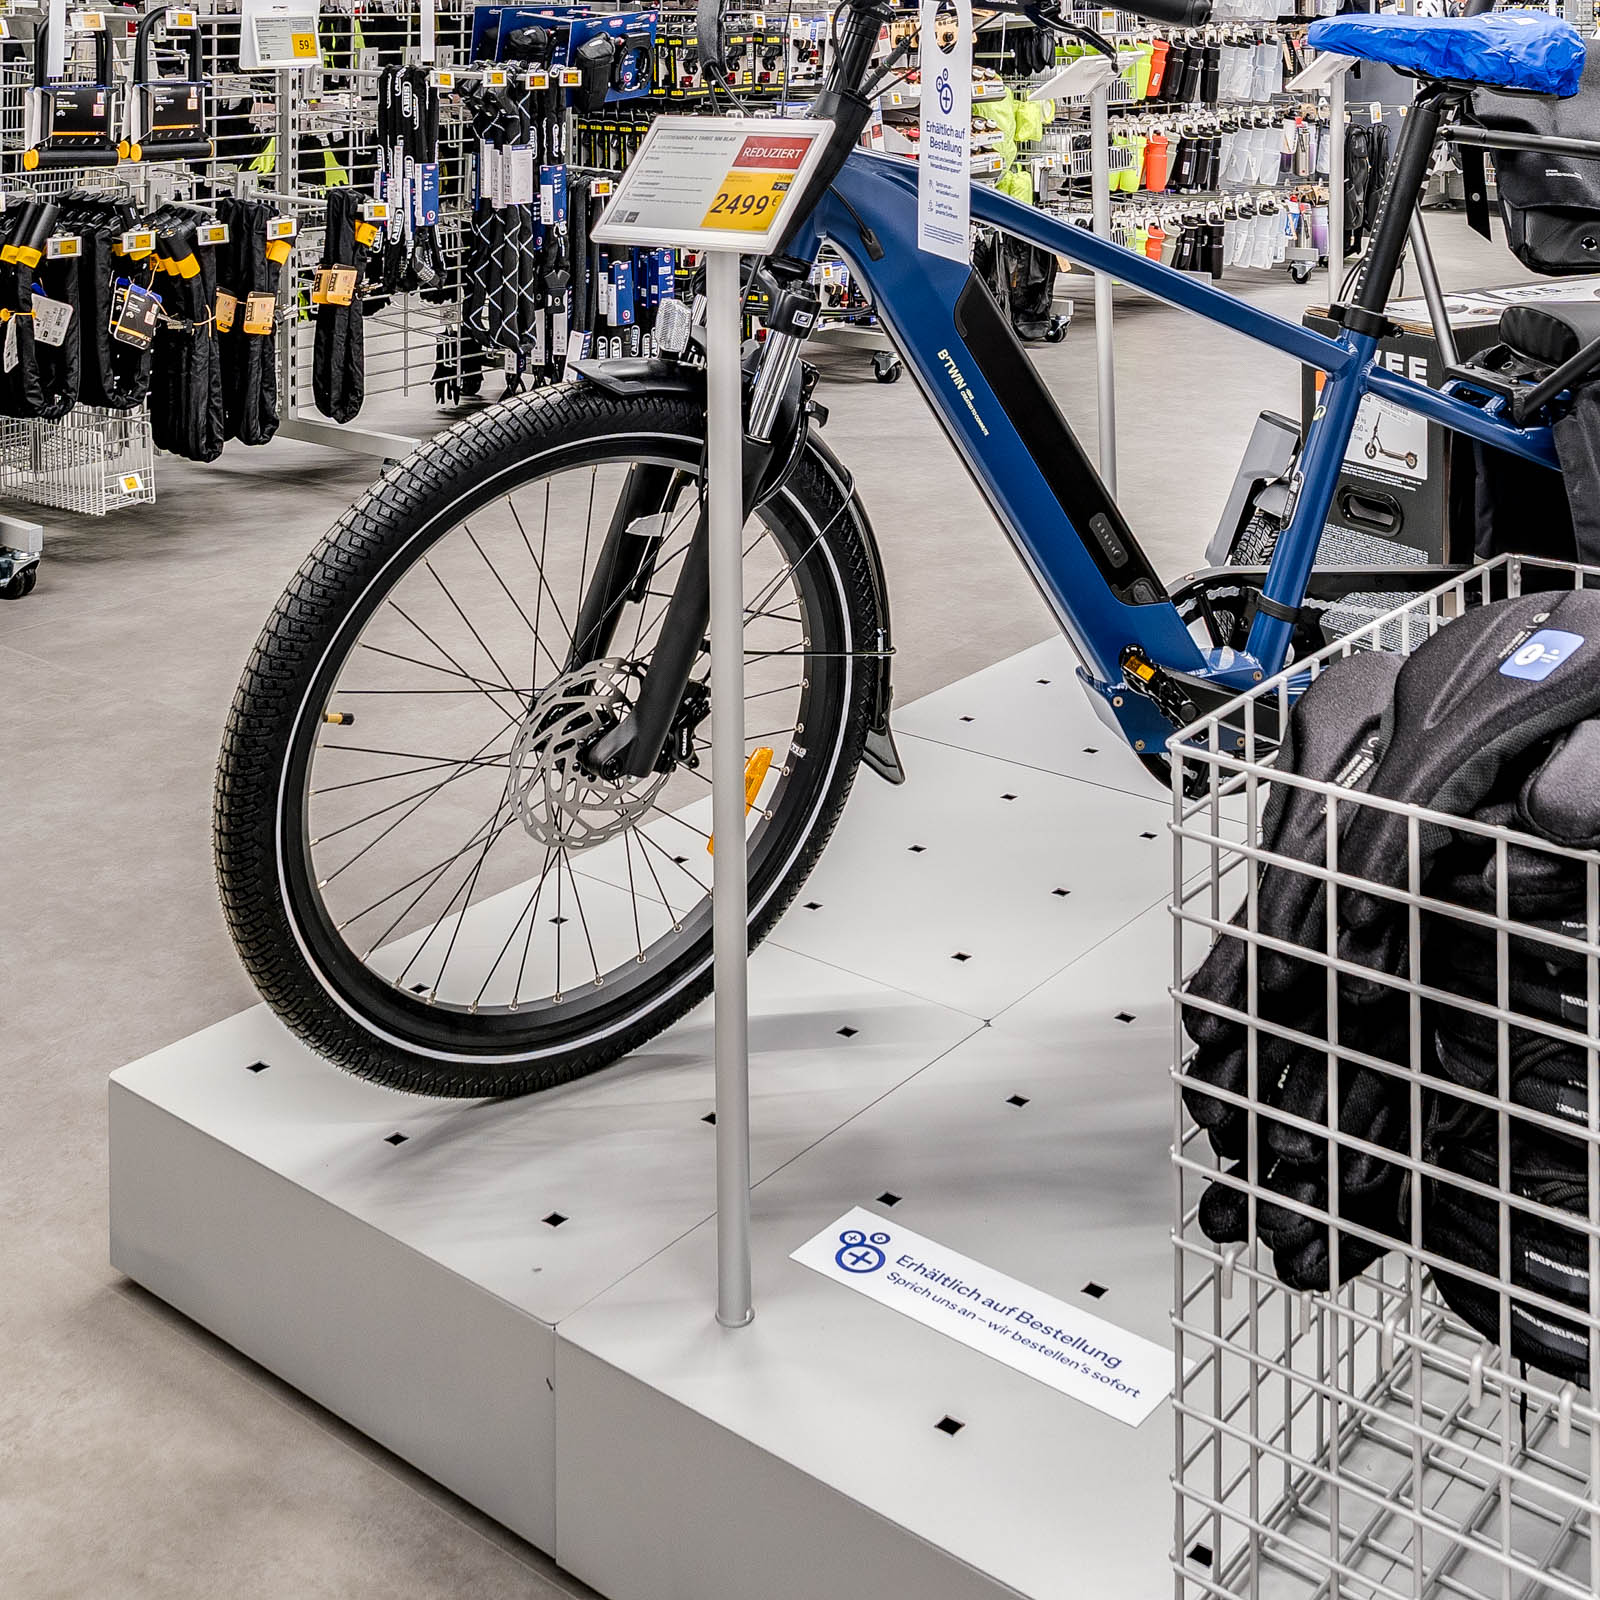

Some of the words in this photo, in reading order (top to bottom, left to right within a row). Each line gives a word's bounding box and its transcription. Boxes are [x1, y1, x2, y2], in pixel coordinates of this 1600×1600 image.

[299, 39, 310, 50] 59
[926, 120, 954, 138] Erhältlich
[955, 127, 965, 140] auf
[742, 147, 803, 160] REDUZIERT
[930, 136, 962, 158] Bestellung
[710, 193, 769, 216] 2499
[937, 349, 967, 390] B'TWIN
[896, 1254, 982, 1302] Erhältlich
[984, 1296, 1018, 1317] auf
[1015, 1311, 1123, 1370] Bestellung
[886, 1272, 931, 1300] Sprich
[931, 1295, 959, 1311] uns
[958, 1307, 976, 1321] an
[987, 1319, 1012, 1336] wir
[1091, 1367, 1141, 1400] sofort
